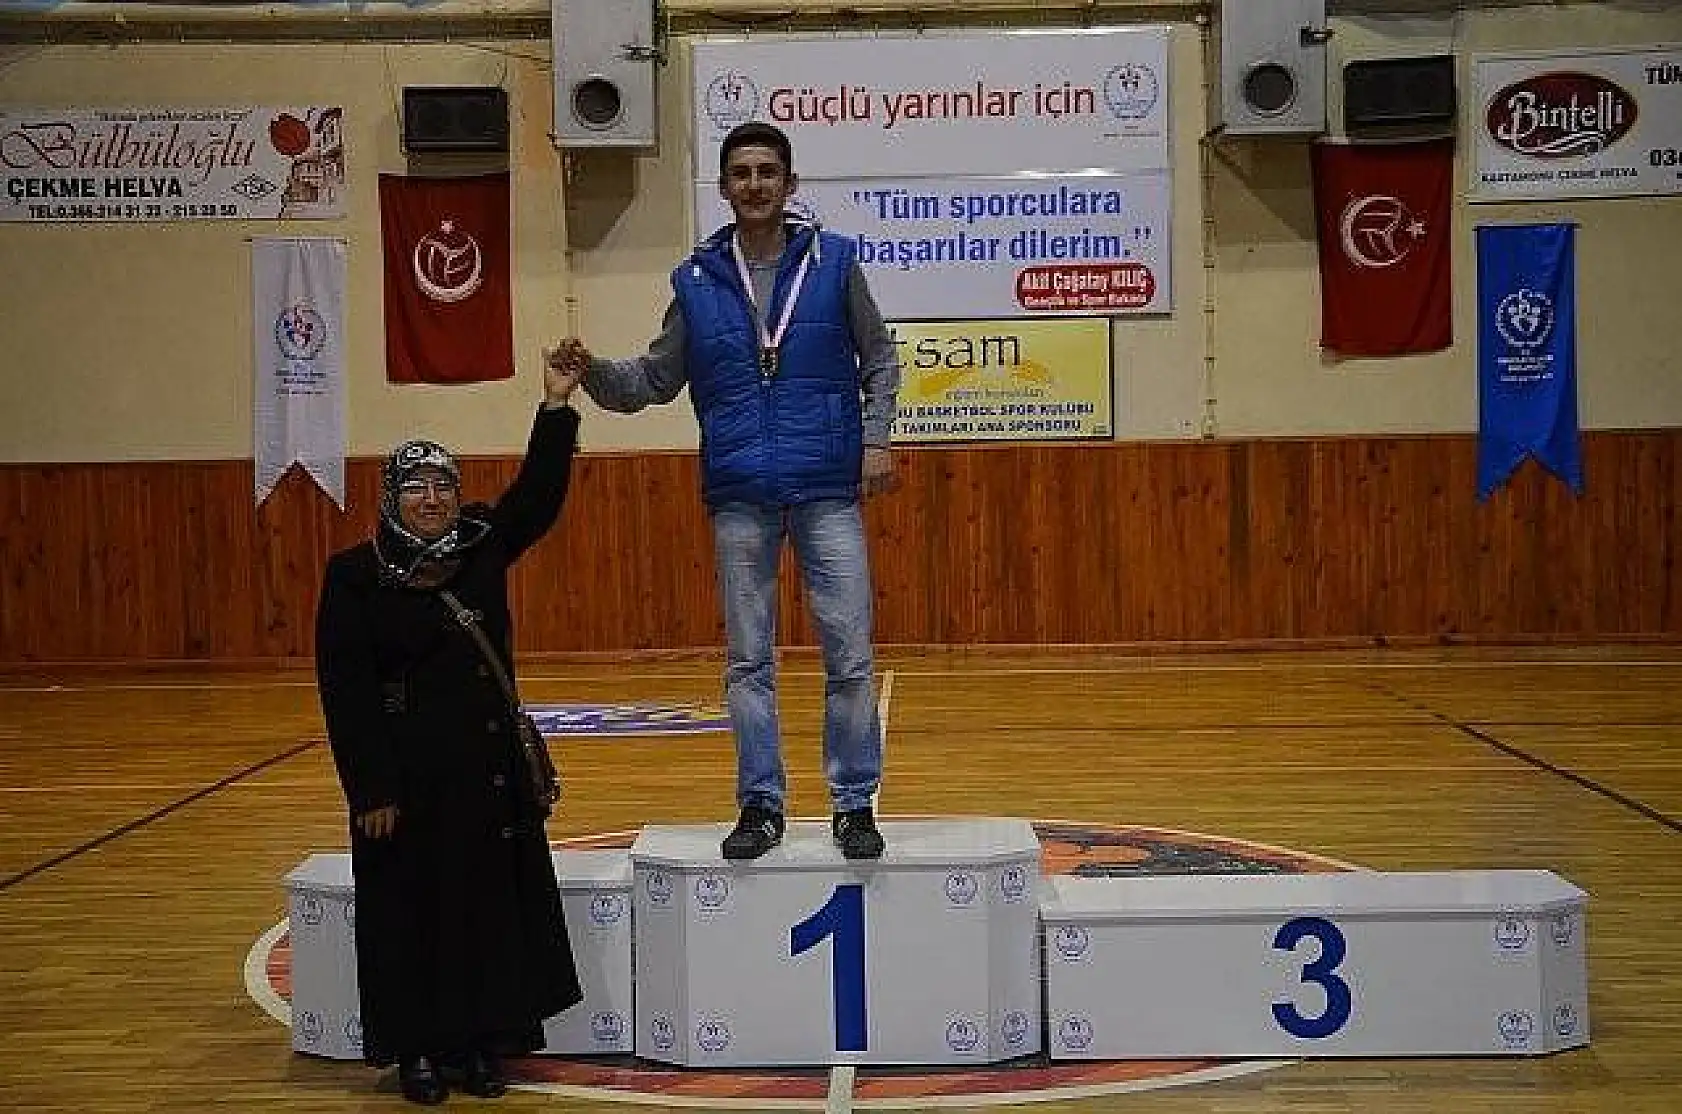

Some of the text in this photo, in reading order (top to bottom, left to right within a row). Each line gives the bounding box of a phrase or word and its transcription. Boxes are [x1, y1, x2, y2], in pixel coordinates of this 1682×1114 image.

[769, 81, 1094, 129] Güçlü yarınlar için
[0, 122, 256, 182] Bülbüloğlu
[1650, 150, 1682, 166] 03
[8, 178, 183, 204] ÇEKME HELVA
[949, 186, 1121, 223] sporculara
[856, 230, 1000, 271] başarılar
[917, 404, 996, 418] BASKETBOL
[1001, 403, 1036, 416] SPOR
[790, 884, 867, 1052] 1
[1270, 915, 1352, 1039] 3
